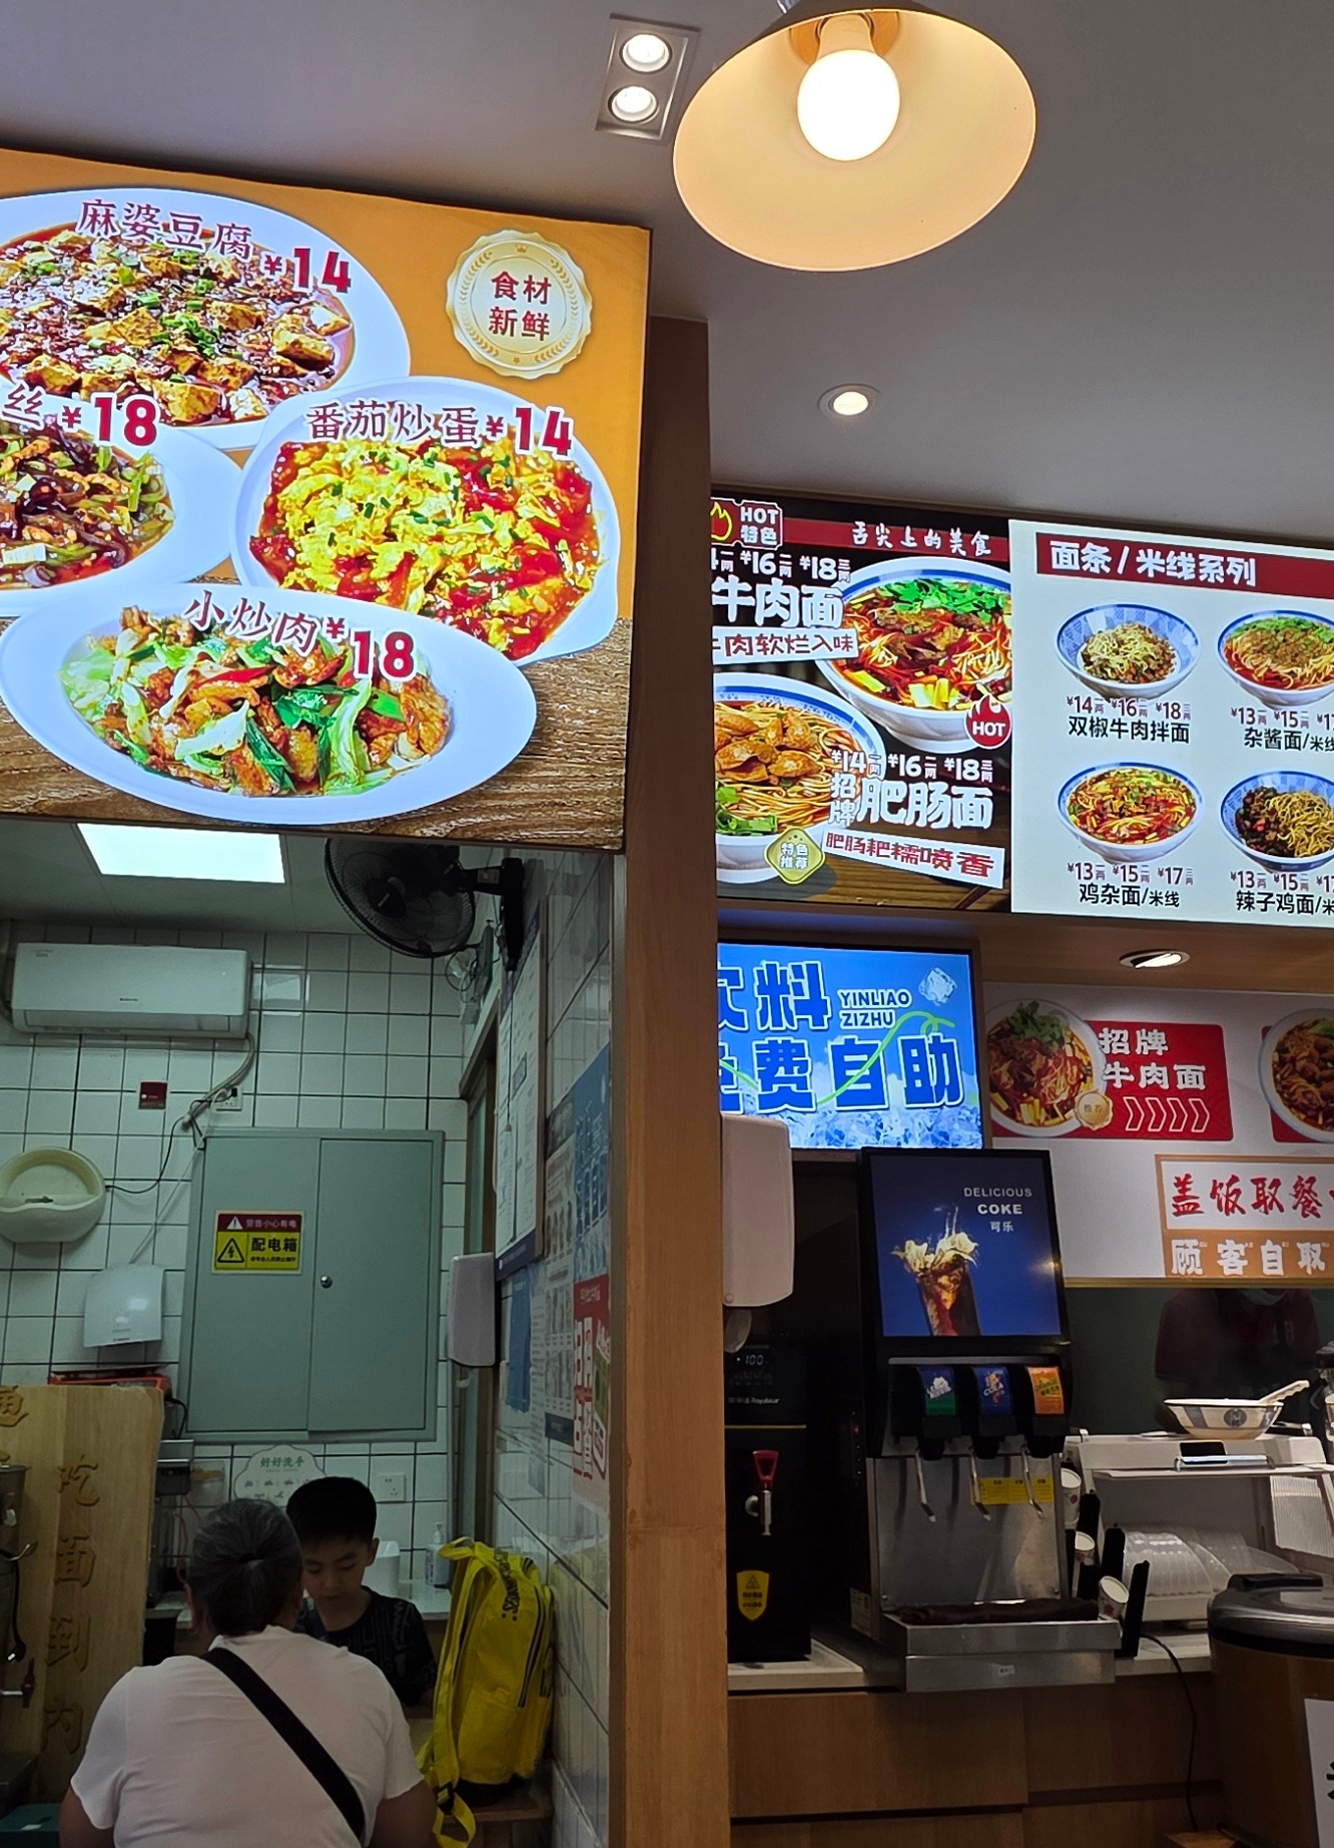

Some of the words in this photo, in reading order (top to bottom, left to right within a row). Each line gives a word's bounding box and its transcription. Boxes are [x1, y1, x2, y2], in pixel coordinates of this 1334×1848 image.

[78, 199, 252, 261] 麻婆豆腐
[264, 245, 352, 294] ¥14
[492, 272, 553, 305] 食材
[489, 306, 552, 342] 新鲜
[60, 393, 158, 447] ¥18
[307, 404, 480, 449] 番茄炒蛋
[484, 408, 574, 457] ¥14
[741, 507, 779, 526] HOT
[741, 526, 778, 546] 特色
[851, 520, 992, 557] 舌尖上的美食
[1050, 541, 1257, 587] 面条/米线系列
[711, 574, 844, 629] 牛肉面
[185, 590, 317, 655] 小炒肉
[325, 617, 414, 678] ¥18
[972, 720, 1006, 737] HOT
[1068, 716, 1190, 744] 双椒牛肉拌面
[827, 772, 856, 827] 招牌
[856, 778, 993, 830] 肥肠面
[780, 856, 808, 869] 推荐
[781, 843, 809, 856] 特色
[1079, 883, 1180, 908] 鸡杂面/米线
[838, 990, 911, 1007] YINLIAO
[841, 1011, 895, 1027] ZIZHU
[1099, 1027, 1169, 1057] 招牌
[1101, 1063, 1207, 1091] 牛肉面
[964, 1187, 1032, 1197] DELICIOUS
[977, 1204, 1023, 1215] COKE
[990, 1221, 1014, 1233] 可乐
[251, 1237, 297, 1252] 配电箱
[260, 1456, 305, 1467] 好好洗手
